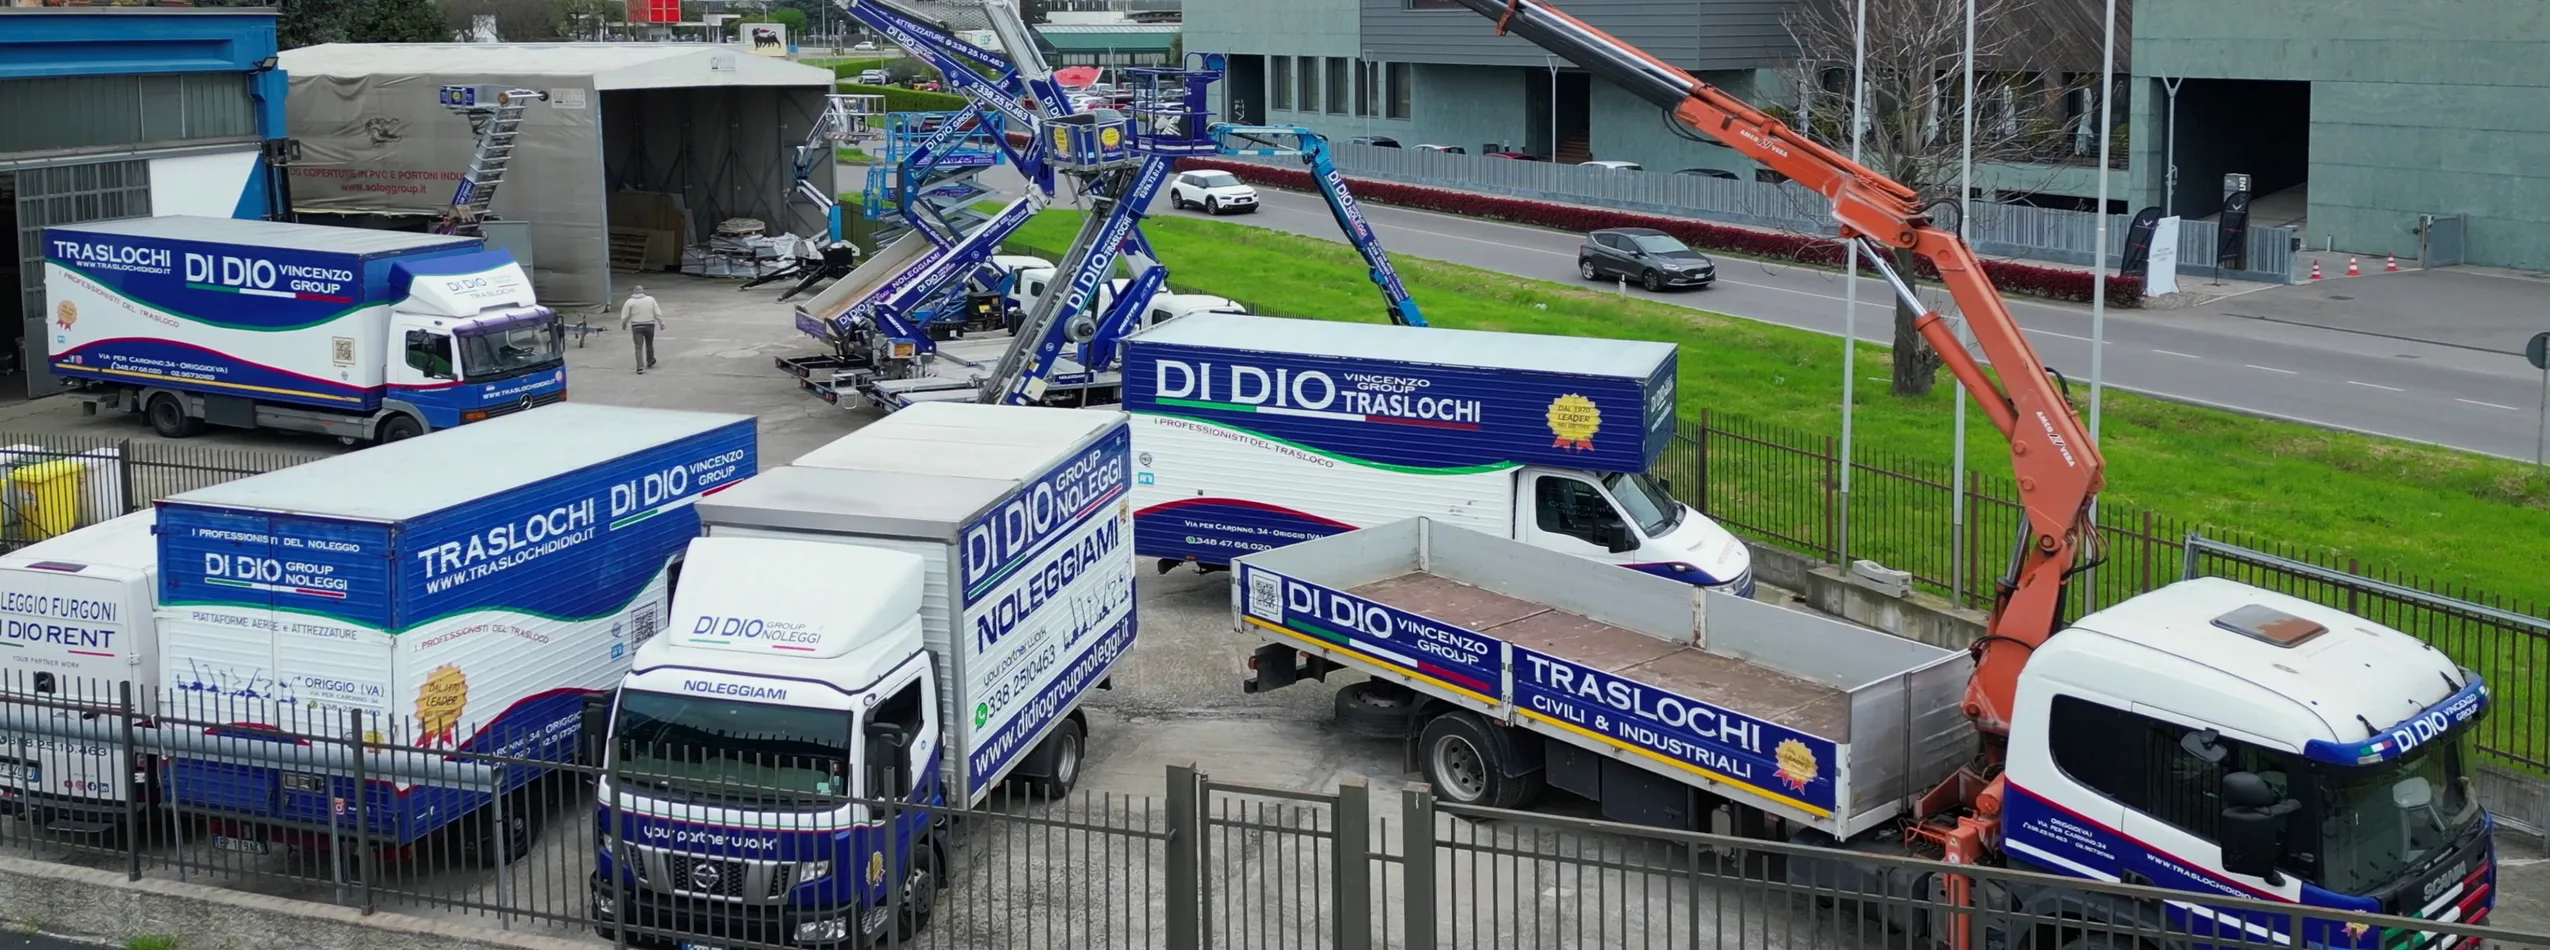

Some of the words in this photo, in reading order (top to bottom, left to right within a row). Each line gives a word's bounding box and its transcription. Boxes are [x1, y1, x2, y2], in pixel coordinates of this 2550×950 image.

[886, 26, 897, 38] DI
[897, 33, 914, 48] DIO
[895, 17, 946, 42] ATTREZZATURE
[951, 39, 968, 52] 338
[1044, 96, 1053, 108] DI
[926, 138, 938, 151] DI
[937, 126, 953, 142] DIO
[952, 108, 978, 127] GROU
[370, 170, 388, 179] PVC
[390, 171, 396, 180] E
[399, 171, 438, 181] PORTONI
[1328, 170, 1338, 186] DI
[1336, 184, 1353, 206] DIO
[1104, 216, 1133, 257] TRASLOCHI
[54, 240, 171, 267] TRASLOCHI
[185, 252, 214, 284] DI
[222, 256, 276, 289] DIO
[279, 264, 353, 282] VINCENZO
[76, 260, 171, 275] WWW.TRASLOCHIDIDIO.IT
[892, 252, 941, 289] NOLEGGIAMI
[290, 280, 341, 294] GROUP
[447, 280, 464, 292] DI
[464, 278, 488, 289] DIO
[917, 283, 926, 293] DI
[925, 274, 939, 288] DIO
[1068, 287, 1088, 310] DI
[1080, 252, 1108, 290] DIO
[64, 272, 120, 304] PROFESSIONISTI
[122, 302, 136, 314] DEL
[140, 309, 180, 328] TRASLOCO
[850, 303, 866, 318] DIO
[113, 354, 127, 362] PER
[1155, 358, 1212, 401] DI
[1230, 364, 1336, 410] DIO
[1343, 372, 1431, 388] VINCENZO
[1356, 382, 1418, 394] GROUP
[1341, 390, 1481, 424] TRASLOCHI
[1558, 414, 1590, 422] LEADER
[1574, 406, 1591, 414] 1970
[1160, 418, 1248, 444] PROFESSIONISTI
[1250, 438, 1272, 450] DEL
[1274, 444, 1334, 468] TRASLOCO
[2036, 411, 2054, 432] AMCO
[2060, 446, 2076, 468] VEBA
[698, 465, 736, 486] GROUP
[1056, 455, 1122, 524] NOLEGGI
[418, 498, 595, 579] TRASLOCHI
[611, 480, 636, 518] DI
[644, 466, 688, 506] DIO
[690, 449, 744, 476] VINCENZO
[968, 515, 998, 586] DI
[1005, 481, 1053, 558] DIO
[1056, 450, 1101, 492] GROUP
[192, 528, 196, 536] I
[200, 529, 278, 545] PROFESSIONISTI
[284, 538, 304, 548] DEL
[308, 540, 360, 553] NOLEGGIO
[1196, 538, 1217, 546] 348
[205, 553, 230, 577] DI
[237, 555, 282, 582] DIO
[285, 561, 334, 575] GROUP
[426, 526, 596, 594] WWW.TRASLOCHIDIDIO.IT
[285, 574, 348, 590] NOLEGGI
[977, 514, 1120, 655] NOLEGGIAMI
[52, 597, 116, 622] FURGONI
[1288, 580, 1321, 618] DI
[1330, 594, 1393, 639] DIO
[1396, 617, 1488, 655] VINCENZO
[8, 620, 42, 641] DIO
[46, 625, 116, 648] RENT
[192, 612, 248, 628] PIATTAFORME
[291, 624, 357, 640] ATTREZZATURE
[422, 624, 488, 650] PROFESSIONISTI
[492, 624, 506, 633] DEL
[693, 616, 720, 634] DI
[721, 618, 764, 638] DIO
[766, 621, 806, 630] GROUP
[761, 630, 821, 644] NOLEGGI
[12, 656, 29, 664] YOUR
[30, 658, 60, 667] PARTNER
[983, 668, 1000, 687] your
[1002, 644, 1027, 672] partner
[1027, 626, 1047, 649] work
[1417, 640, 1479, 666] GROUP
[304, 677, 355, 693] ORIGGIO
[360, 684, 384, 698] (VA)
[684, 680, 788, 700] NOLEGGIAMI
[988, 684, 1010, 718] 338
[1013, 644, 1056, 698] 2510463
[426, 696, 458, 706] LEADER
[975, 617, 1129, 776] www.didiogroupnoleggi.it
[1526, 654, 1762, 754] TRASLOCHI
[2443, 694, 2476, 716] VINCENZO
[2456, 704, 2478, 722] GROUP
[1532, 694, 1585, 724] CIVILI
[1594, 714, 1610, 732] &
[1620, 721, 1752, 779] INDUSTRIALI
[2392, 730, 2417, 754] DI
[2420, 711, 2448, 742] DIO
[2037, 820, 2048, 828] VIA
[2050, 825, 2063, 834] PER
[2423, 860, 2468, 901] SCANIA
